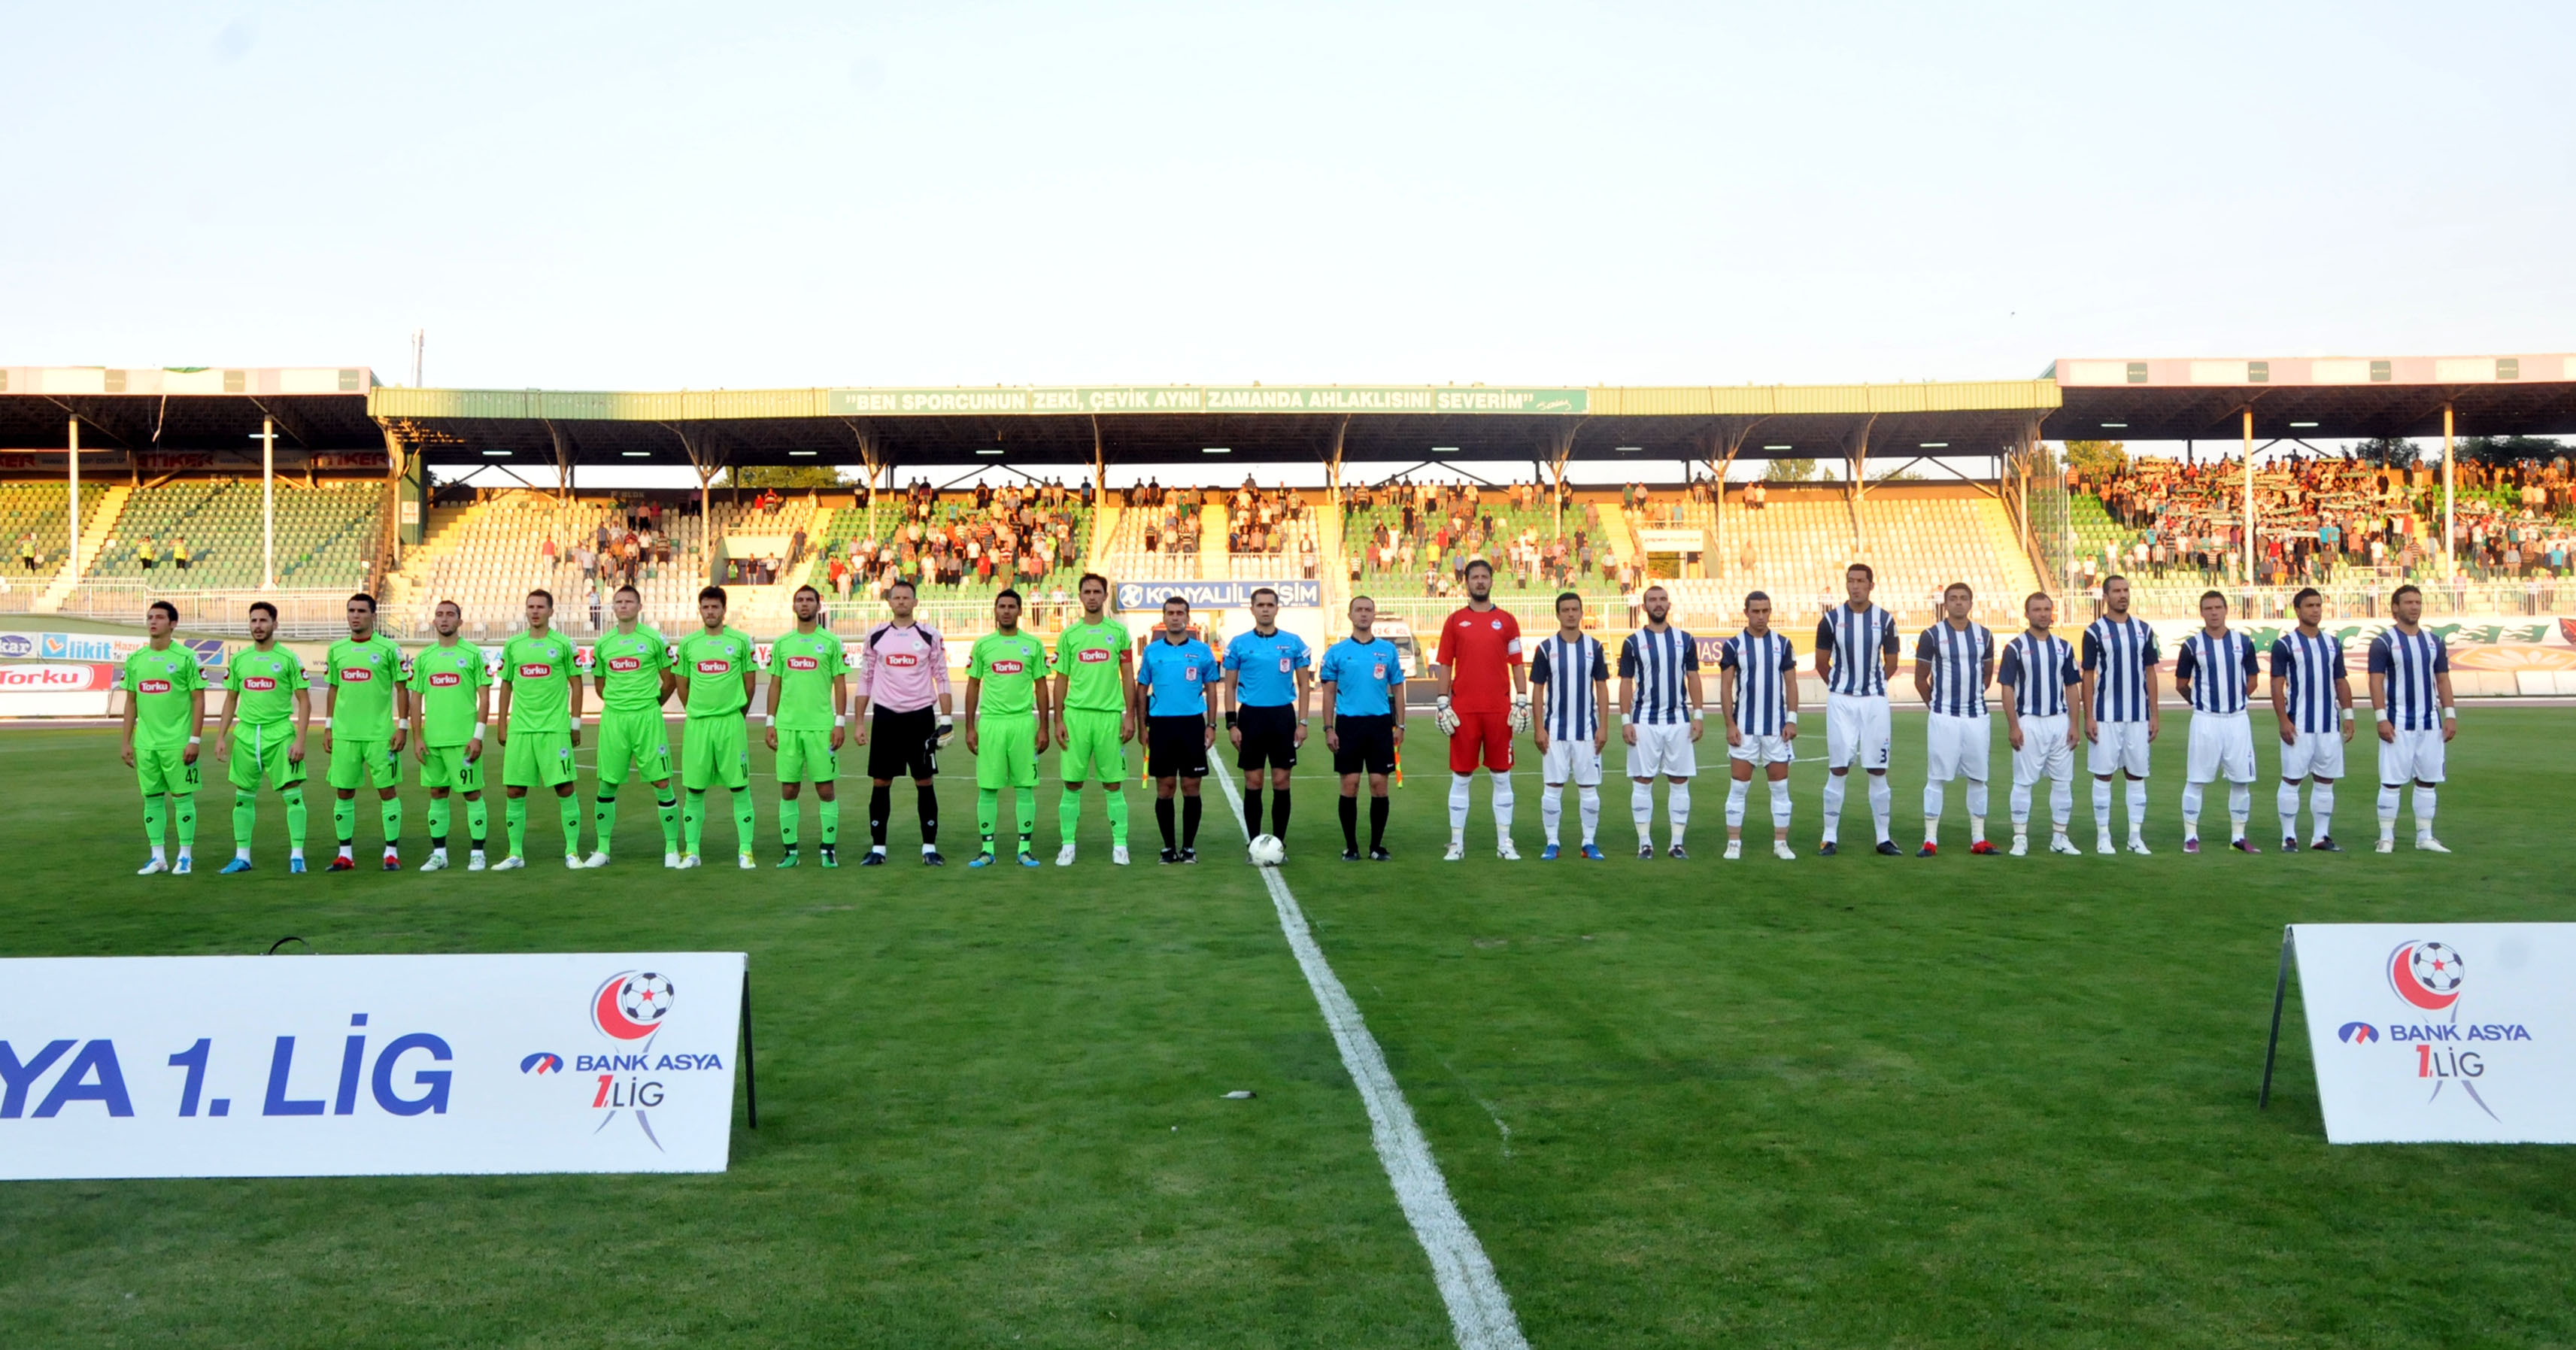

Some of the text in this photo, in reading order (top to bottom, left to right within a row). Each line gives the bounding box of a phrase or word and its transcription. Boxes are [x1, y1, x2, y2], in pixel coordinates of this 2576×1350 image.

[902, 393, 1026, 411] SPORCUNUN
[1090, 388, 1149, 411] ÇEVİK
[1154, 391, 1200, 408] AYNI
[1208, 391, 1303, 408] ZAMANDA
[1308, 391, 1431, 408] AHLAKLISINI
[69, 640, 111, 660] likit
[888, 655, 915, 665] Torku
[1081, 651, 1107, 660] Torku
[611, 659, 637, 669] Torku
[699, 662, 727, 672] Torku
[789, 658, 815, 668] Torku
[994, 662, 1021, 672] Torku
[343, 669, 369, 679] Torku
[522, 666, 548, 675] Torku
[0, 669, 79, 685] Torku
[432, 675, 457, 684] Torku
[141, 681, 168, 691] Torku
[246, 679, 272, 689] Torku
[185, 767, 199, 785] 42
[460, 768, 473, 785] 91
[2389, 1024, 2532, 1042] BANK ASYA
[167, 1037, 231, 1118] 1.
[262, 1012, 454, 1117] LİG
[575, 1054, 723, 1072] BANK ASYA
